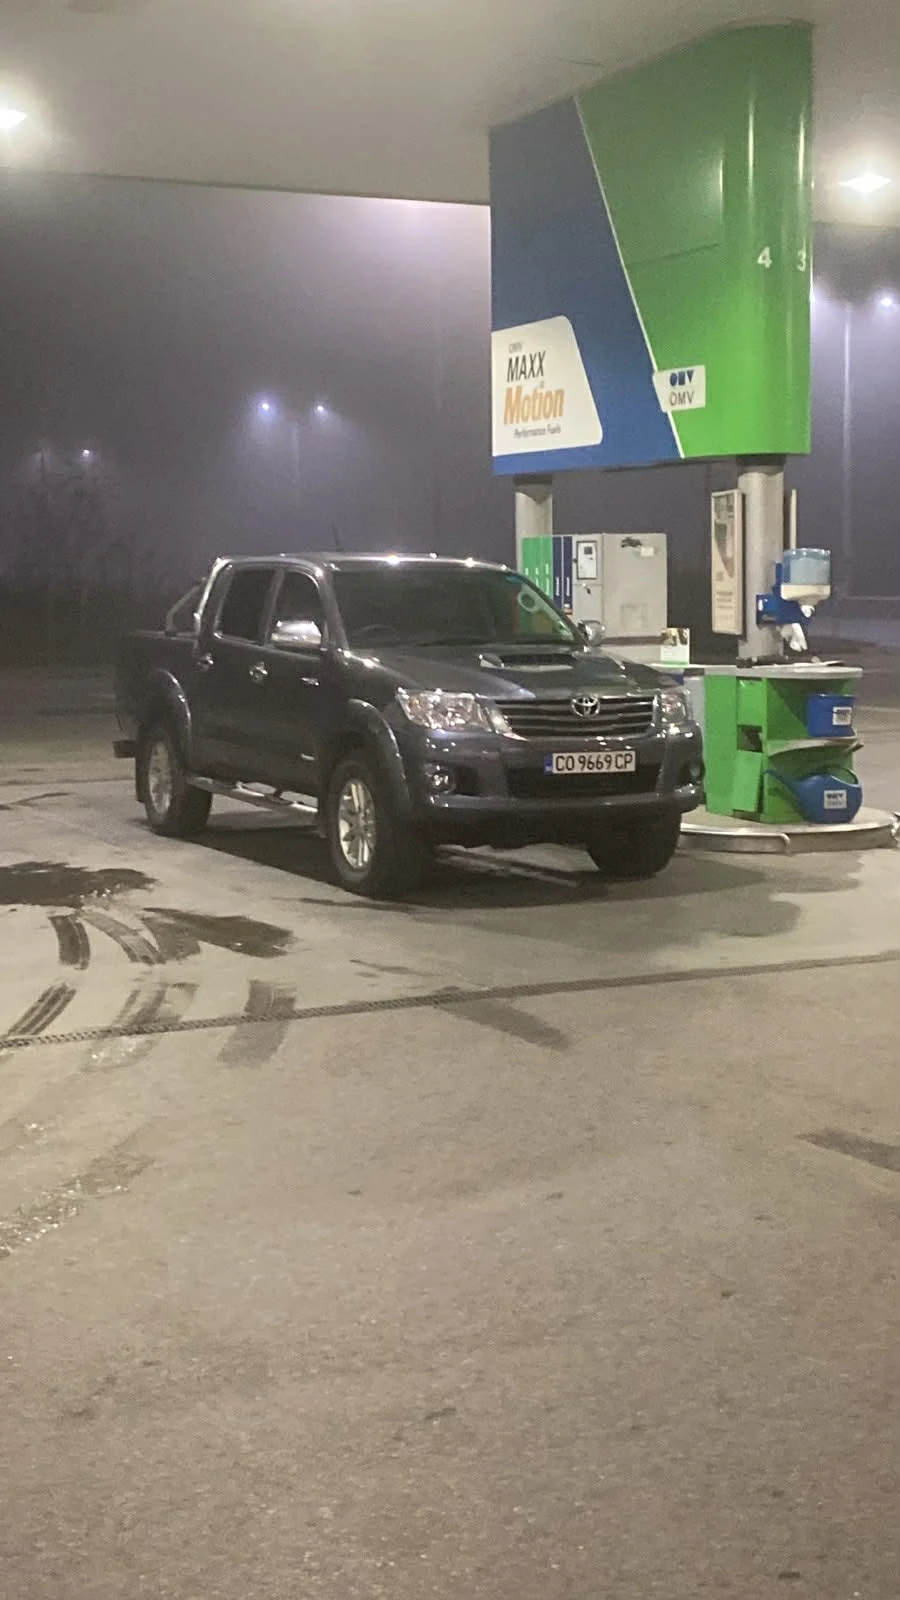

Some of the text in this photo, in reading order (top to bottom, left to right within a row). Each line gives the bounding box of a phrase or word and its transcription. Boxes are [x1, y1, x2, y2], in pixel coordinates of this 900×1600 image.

[757, 246, 772, 269] 4
[797, 250, 807, 272] 3
[506, 350, 547, 383] MAXX
[504, 385, 565, 425] Motion
[669, 391, 694, 408] OMV
[578, 754, 612, 771] 9669
